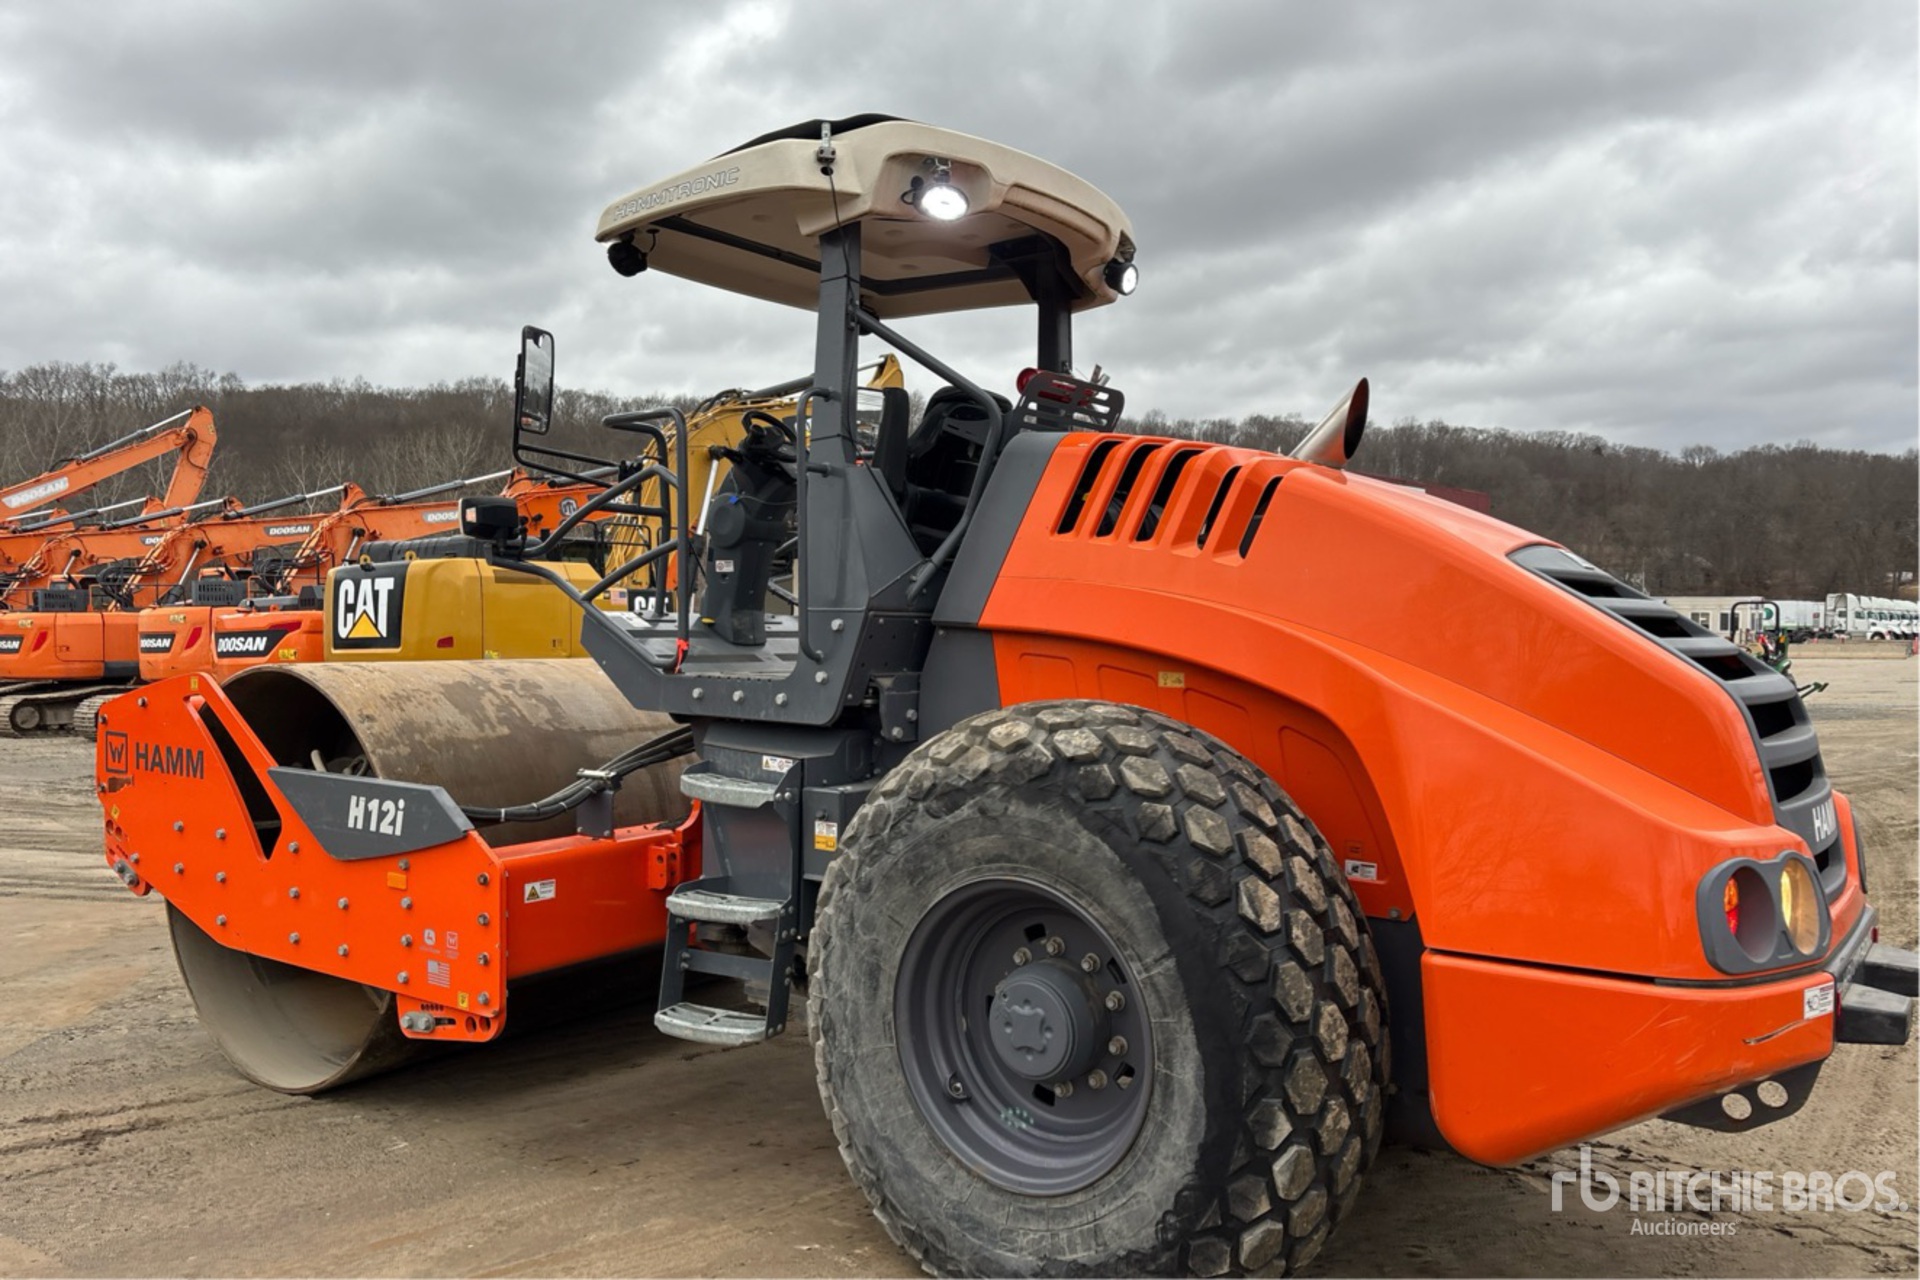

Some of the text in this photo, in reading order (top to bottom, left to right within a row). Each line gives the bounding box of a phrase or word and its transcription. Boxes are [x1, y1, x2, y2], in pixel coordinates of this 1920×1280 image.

[613, 167, 740, 221] HAMMTRONIC
[269, 525, 310, 535] DOOSAN
[337, 577, 395, 639] CAT
[217, 636, 268, 652] DOOSAN
[136, 742, 204, 779] HAMM
[347, 795, 405, 836] H12i
